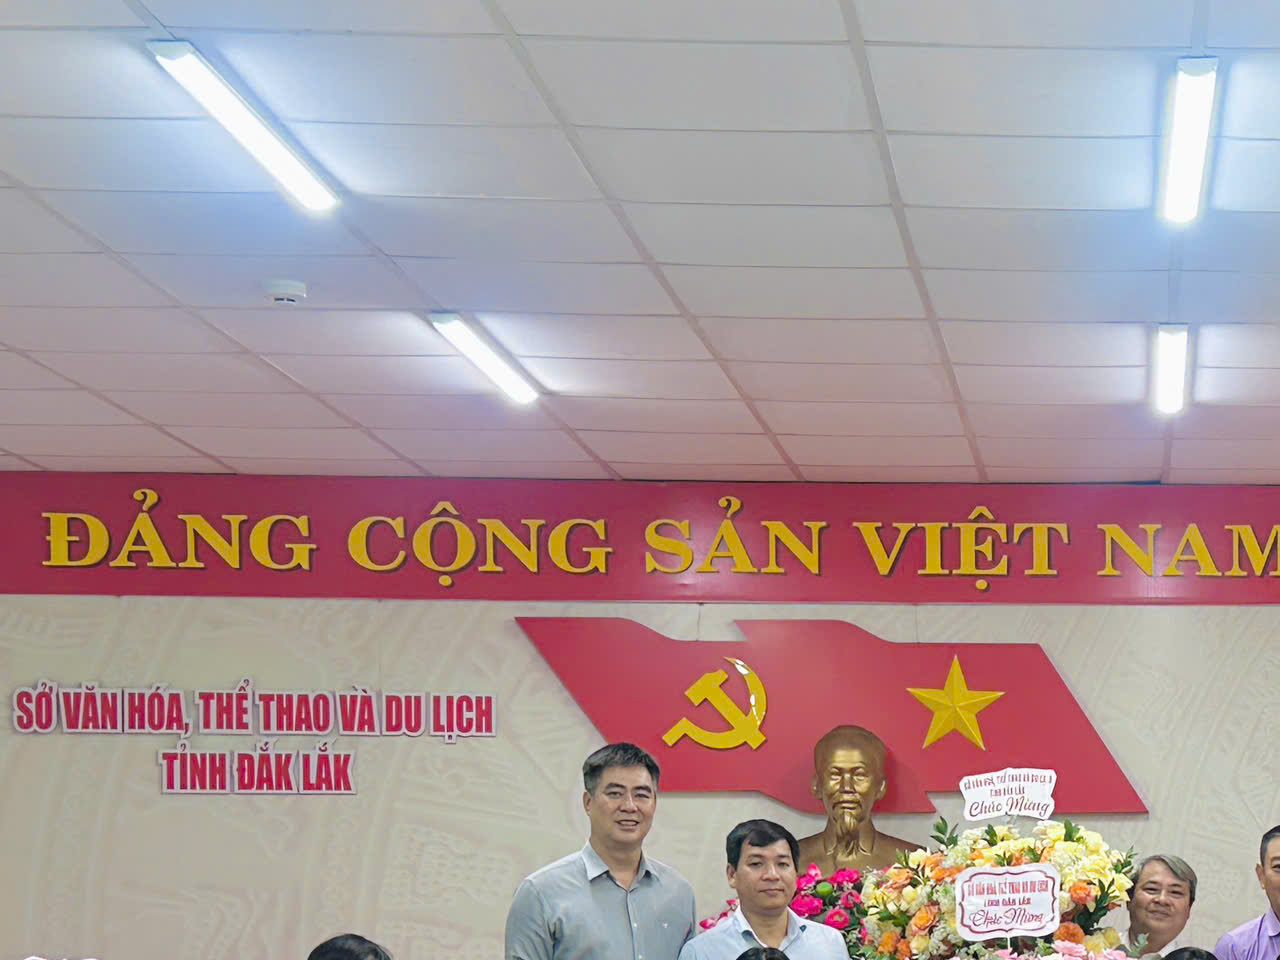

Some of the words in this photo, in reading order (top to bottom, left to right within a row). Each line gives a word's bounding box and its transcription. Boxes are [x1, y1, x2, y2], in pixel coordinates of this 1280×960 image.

[41, 488, 317, 569] ĐẢNG
[347, 500, 612, 587] CỘNG
[644, 495, 827, 575] SẢN
[853, 505, 1069, 590] VIỆT
[16, 682, 54, 730] SỞ
[62, 685, 118, 730] VĂN
[128, 686, 190, 736] HÓA,
[198, 678, 250, 730] THỂ
[258, 693, 331, 732] THAO
[338, 685, 376, 732] VÀ
[385, 695, 422, 732] DU
[432, 695, 493, 741] LỊCH
[162, 743, 227, 790] TỈNH
[236, 741, 293, 791] ĐẮK
[302, 741, 352, 791] LẮK
